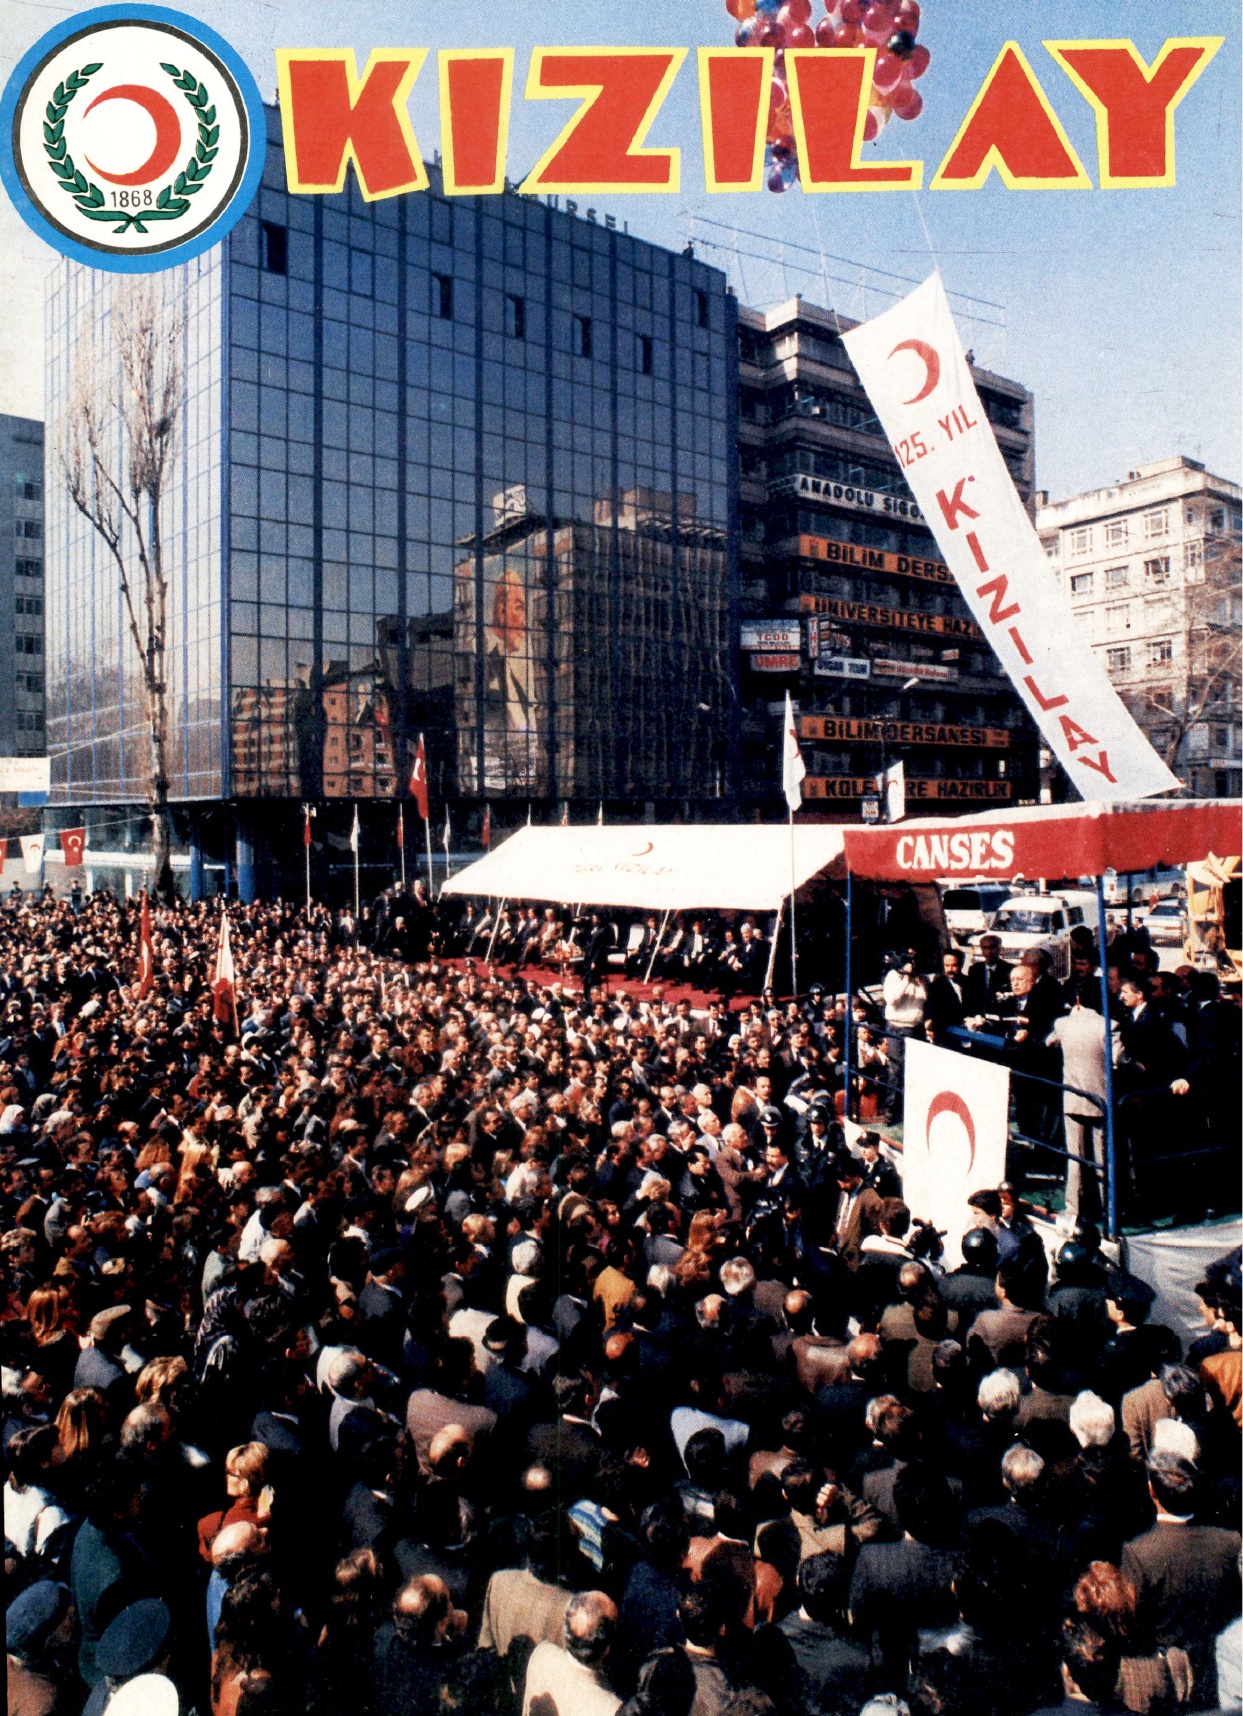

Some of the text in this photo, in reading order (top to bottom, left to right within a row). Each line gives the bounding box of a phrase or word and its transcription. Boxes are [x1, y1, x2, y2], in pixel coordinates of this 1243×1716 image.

[894, 405, 977, 469] 125. YIL
[800, 477, 874, 507] ANADOLU
[897, 556, 956, 582] DERS
[935, 477, 1118, 783] KIZILAY
[896, 829, 1015, 870] CANSES
